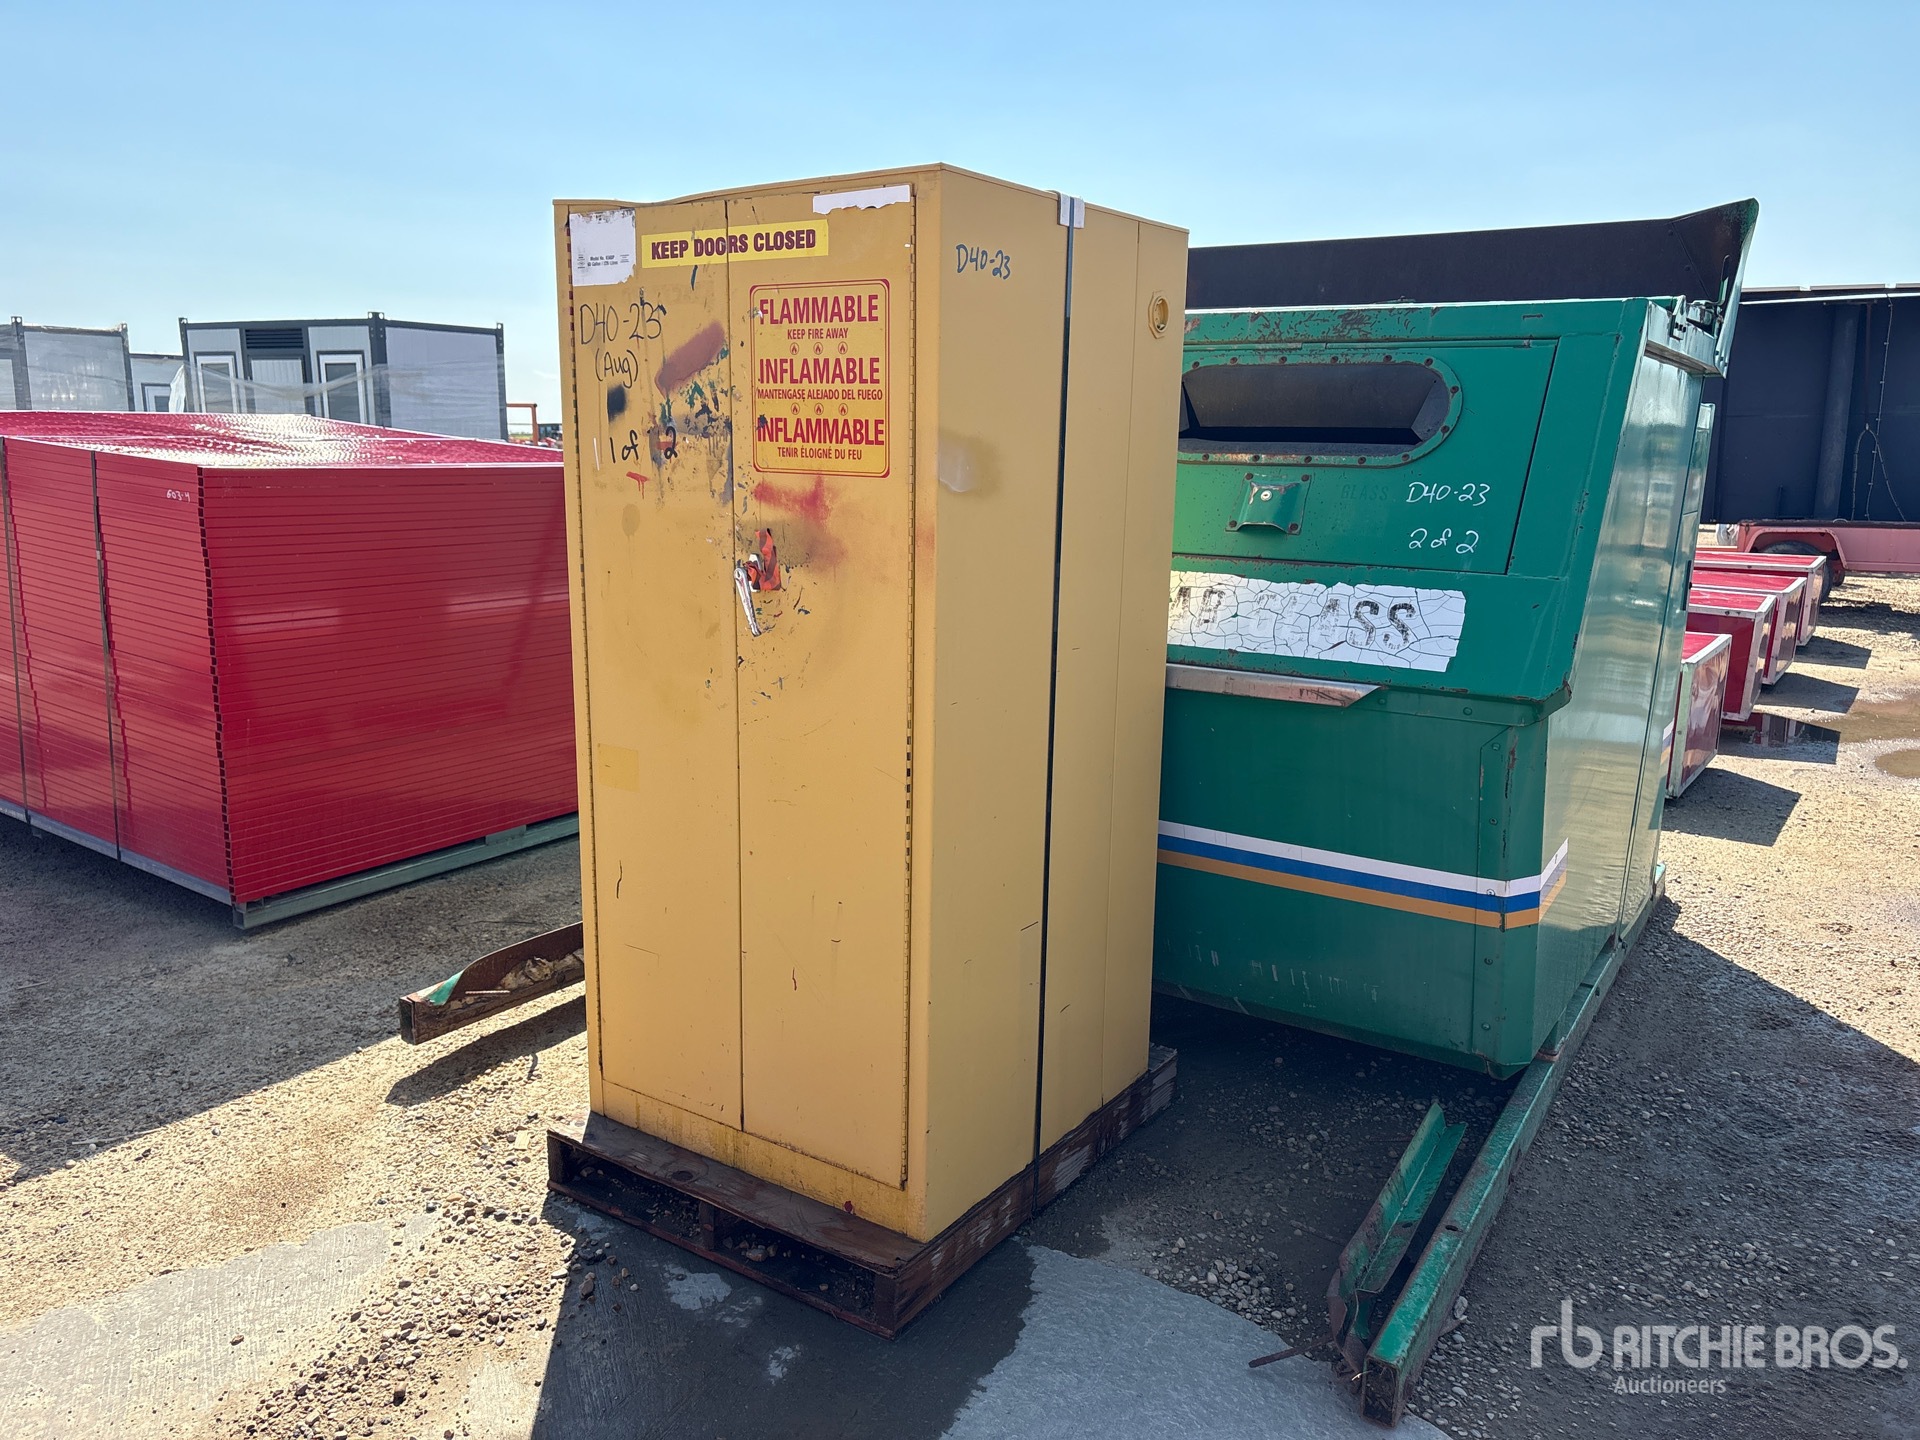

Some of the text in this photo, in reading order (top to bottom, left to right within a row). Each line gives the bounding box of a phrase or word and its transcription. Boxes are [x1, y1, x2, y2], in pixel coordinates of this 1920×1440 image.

[651, 239, 689, 260] KEEP
[693, 233, 749, 257] DOORS
[753, 229, 816, 252] CLOSED
[955, 243, 1011, 280] D40-23
[760, 294, 879, 325] FLAMMABLE
[787, 327, 849, 340] KEEP FIRE AWAY
[595, 347, 639, 389] (Aug)
[759, 357, 880, 385] INFLAMABLE
[757, 388, 883, 400] MANTENGASE ALEJADO DEL FUEGO
[621, 429, 639, 461] of
[664, 425, 678, 460] 2
[757, 417, 885, 446] INFLAMMABLE
[777, 445, 862, 461] TENIR ÉLOIGNÉ DU FEU
[1405, 481, 1491, 507] D40-23
[1408, 527, 1479, 554] 2 of 2
